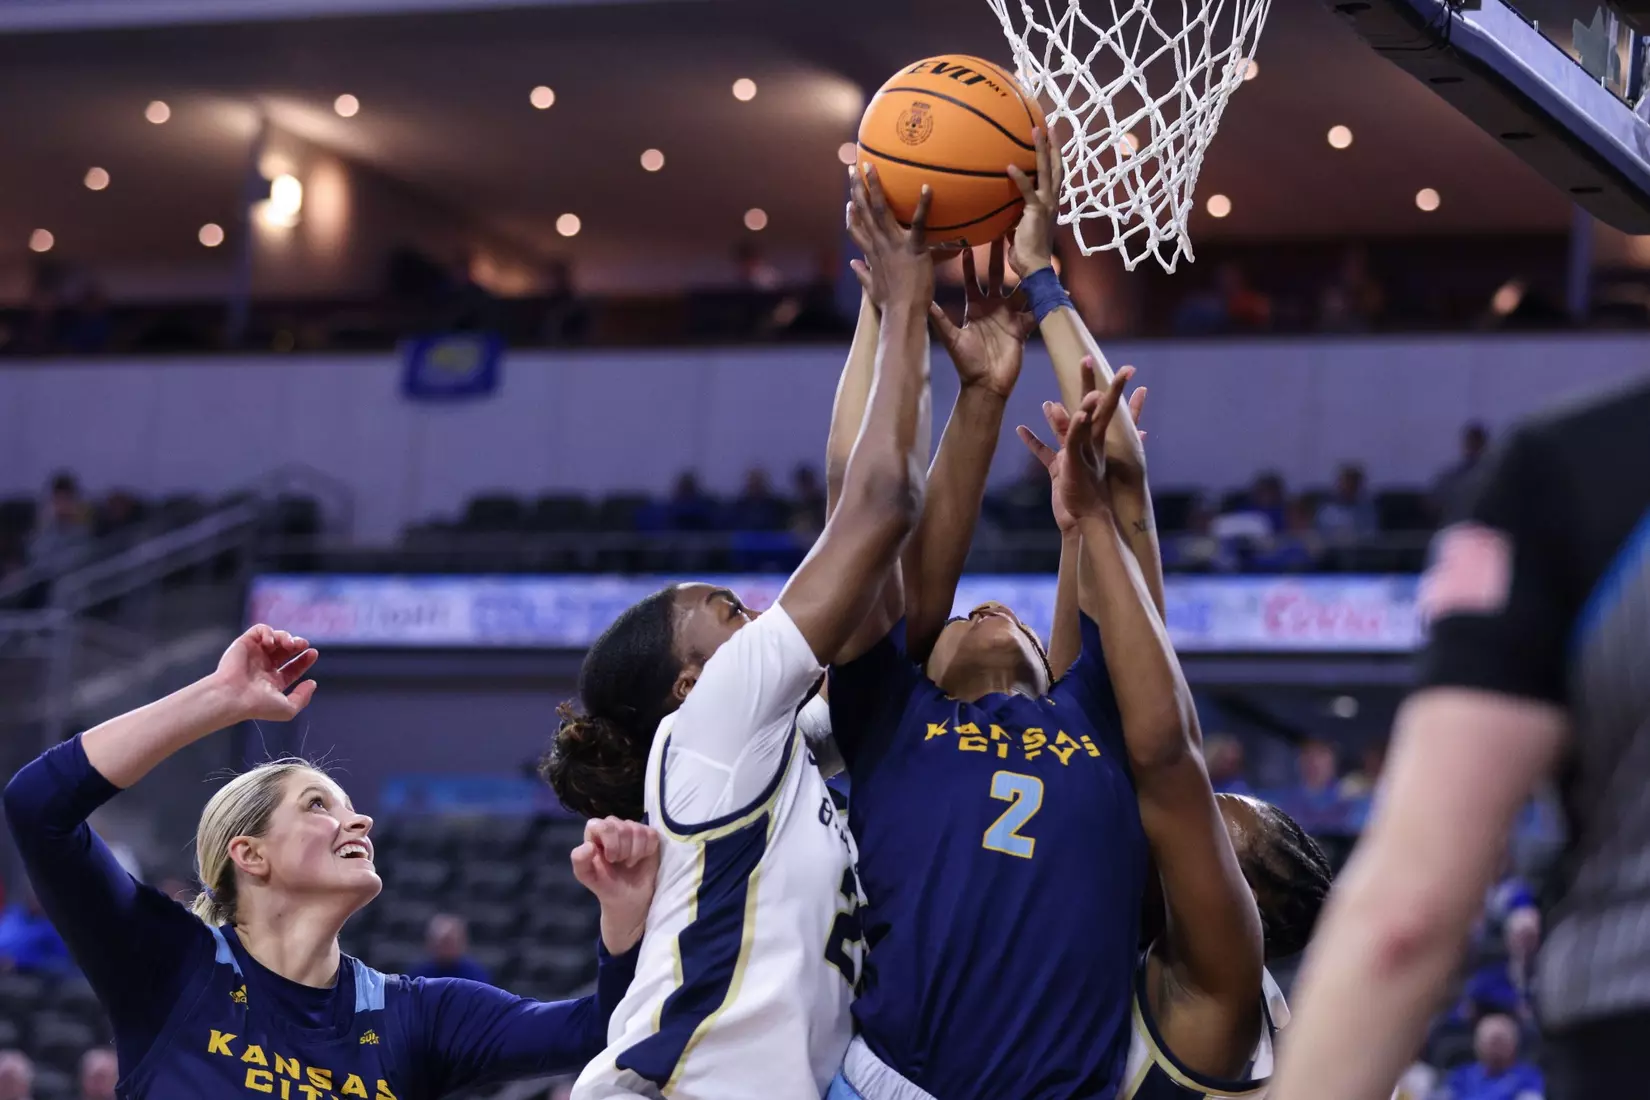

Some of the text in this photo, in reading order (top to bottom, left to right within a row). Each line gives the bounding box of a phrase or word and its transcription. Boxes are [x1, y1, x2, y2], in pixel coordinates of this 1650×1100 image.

[908, 61, 987, 86] EVO
[982, 770, 1044, 859] 2
[207, 1029, 398, 1100] KANSAS
[244, 1068, 340, 1100] CIT
